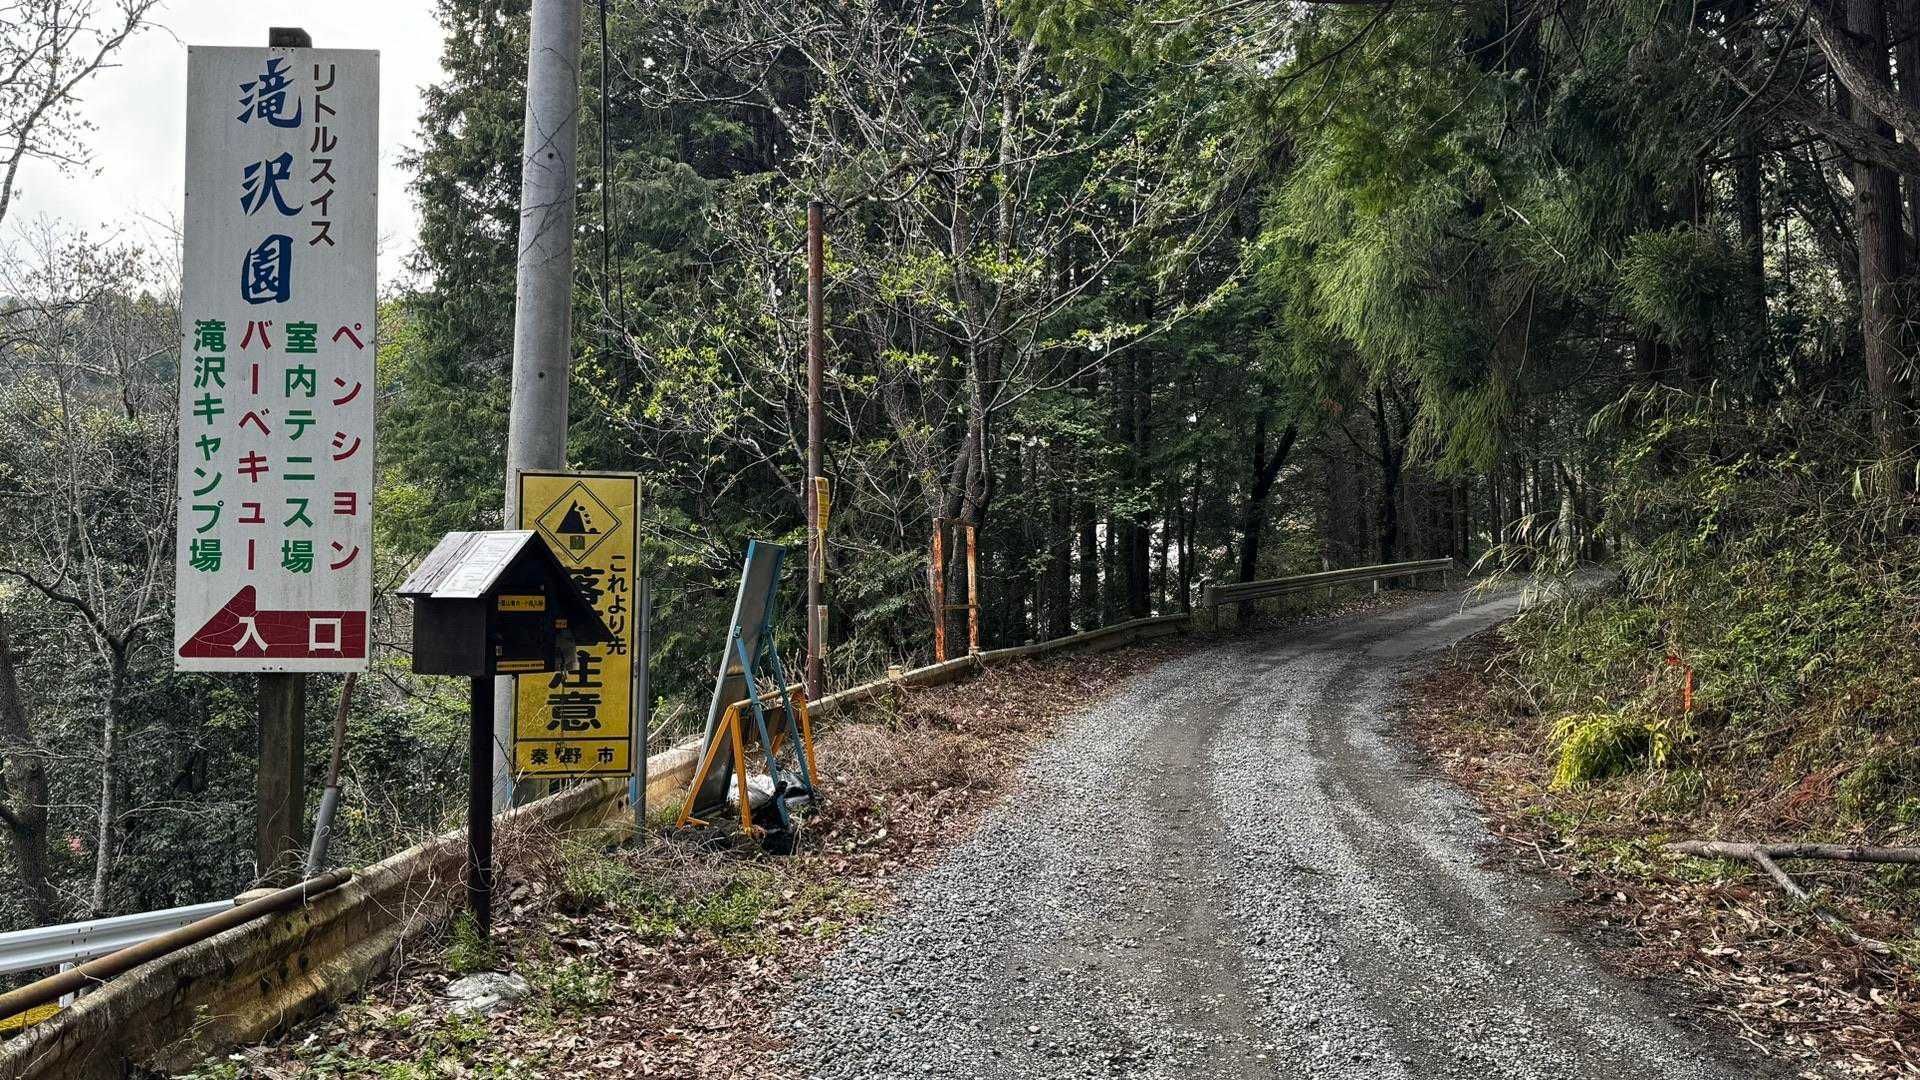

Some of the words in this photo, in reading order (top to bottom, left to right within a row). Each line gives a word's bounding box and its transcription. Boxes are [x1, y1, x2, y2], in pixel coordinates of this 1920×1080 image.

[236, 57, 304, 305] 滝沢園
[309, 64, 338, 247] リトルスイス
[188, 319, 227, 574] 滝沢キャンプ場
[237, 319, 274, 571] バーベキュー
[281, 320, 319, 574] 室内テニス場
[330, 322, 365, 571] ペンション
[232, 616, 342, 653] 入口
[605, 554, 628, 656] これより先
[531, 746, 614, 765] 秦野市
